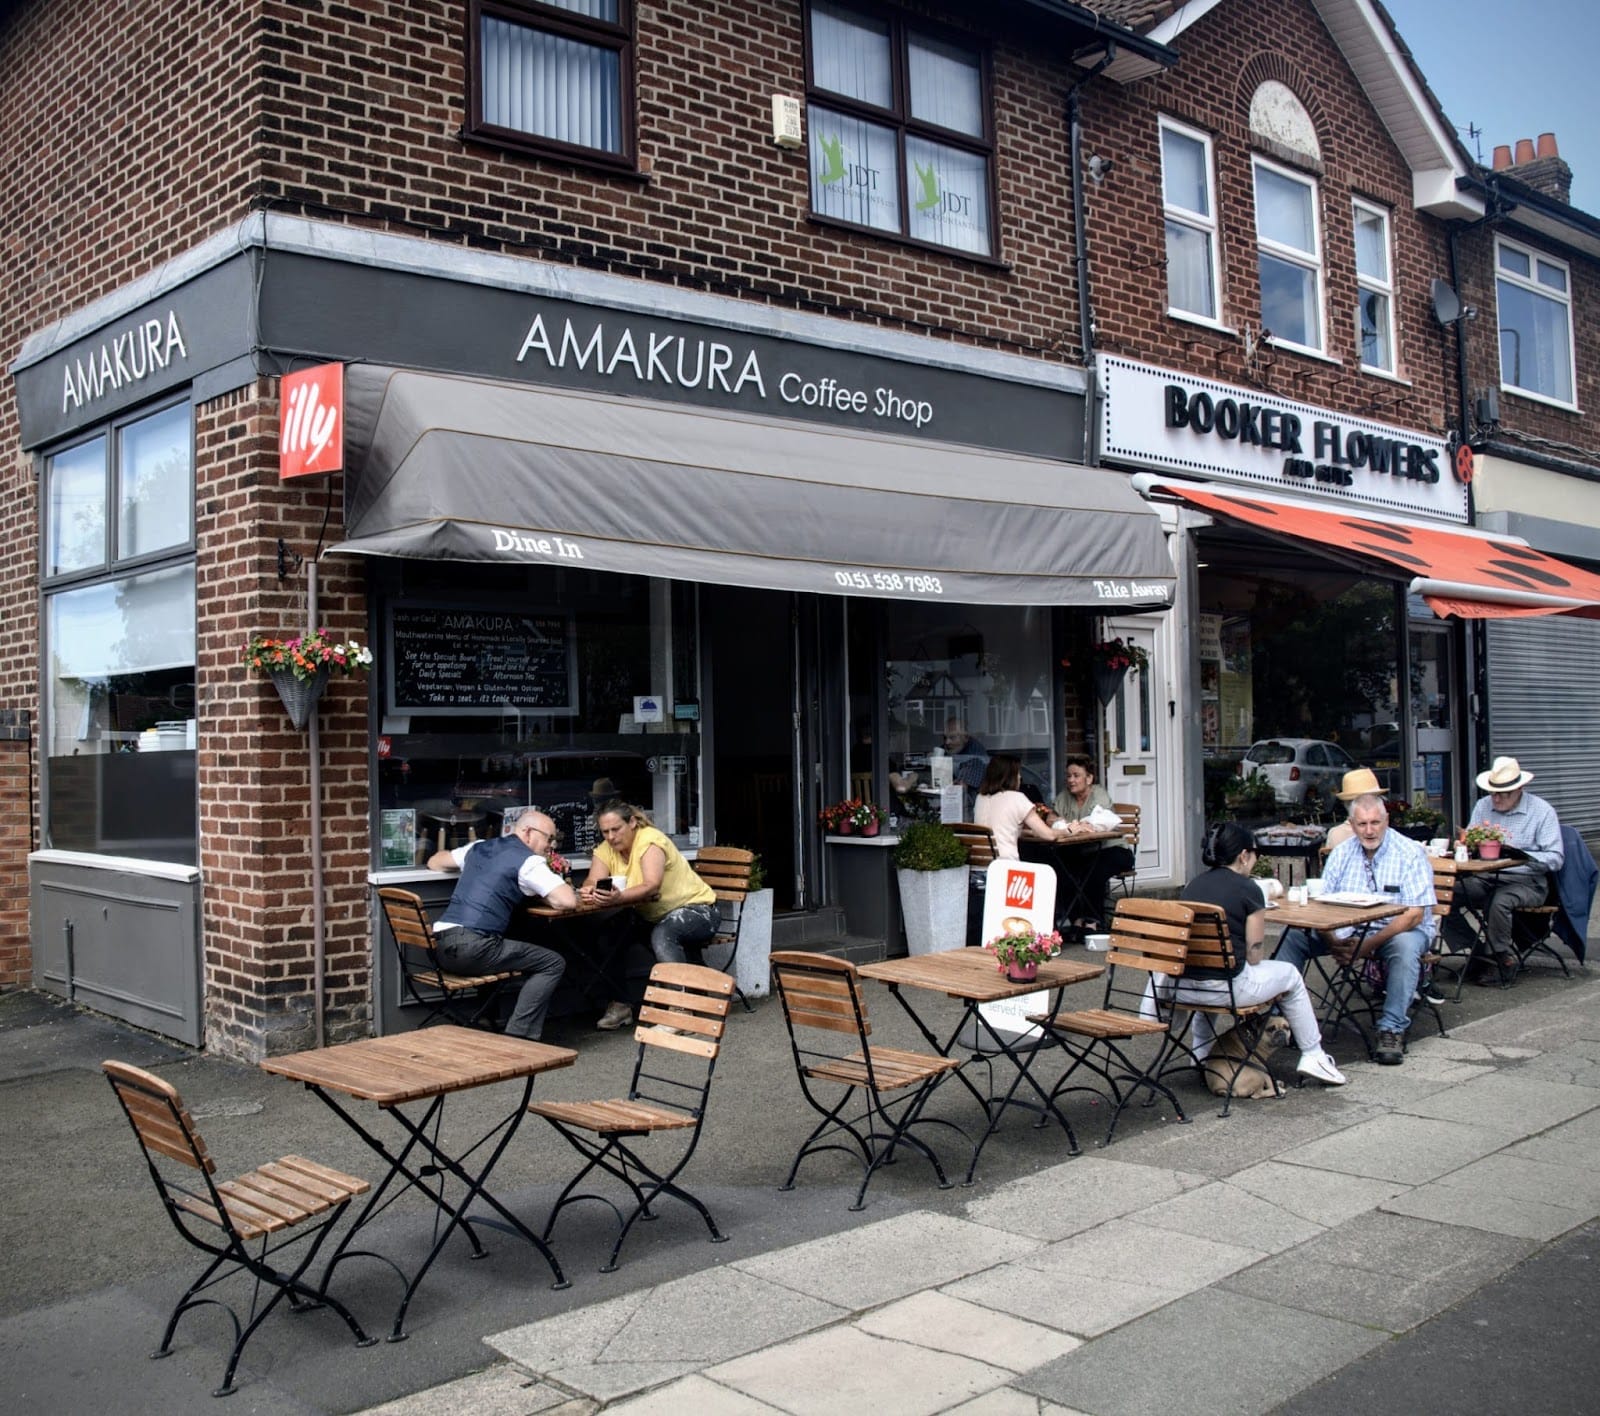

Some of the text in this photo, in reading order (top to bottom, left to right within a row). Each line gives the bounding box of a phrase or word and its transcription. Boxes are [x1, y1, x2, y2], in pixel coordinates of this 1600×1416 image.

[848, 163, 880, 190] JDT
[942, 190, 971, 216] JDT
[63, 310, 187, 414] AMAKURA
[516, 313, 934, 428] AMAKURA Coffee Shop
[282, 382, 337, 465] illy
[1164, 384, 1440, 484] BOOKER FLOWERS
[491, 529, 584, 559] Dine In
[835, 571, 943, 594] 0151 538 7983
[1093, 581, 1168, 601] Take Away
[444, 615, 514, 631] AMAKURA
[405, 650, 417, 661] See
[419, 650, 431, 661] the
[429, 693, 445, 702] Take
[377, 740, 391, 758] lly
[1007, 876, 1032, 905] illy
